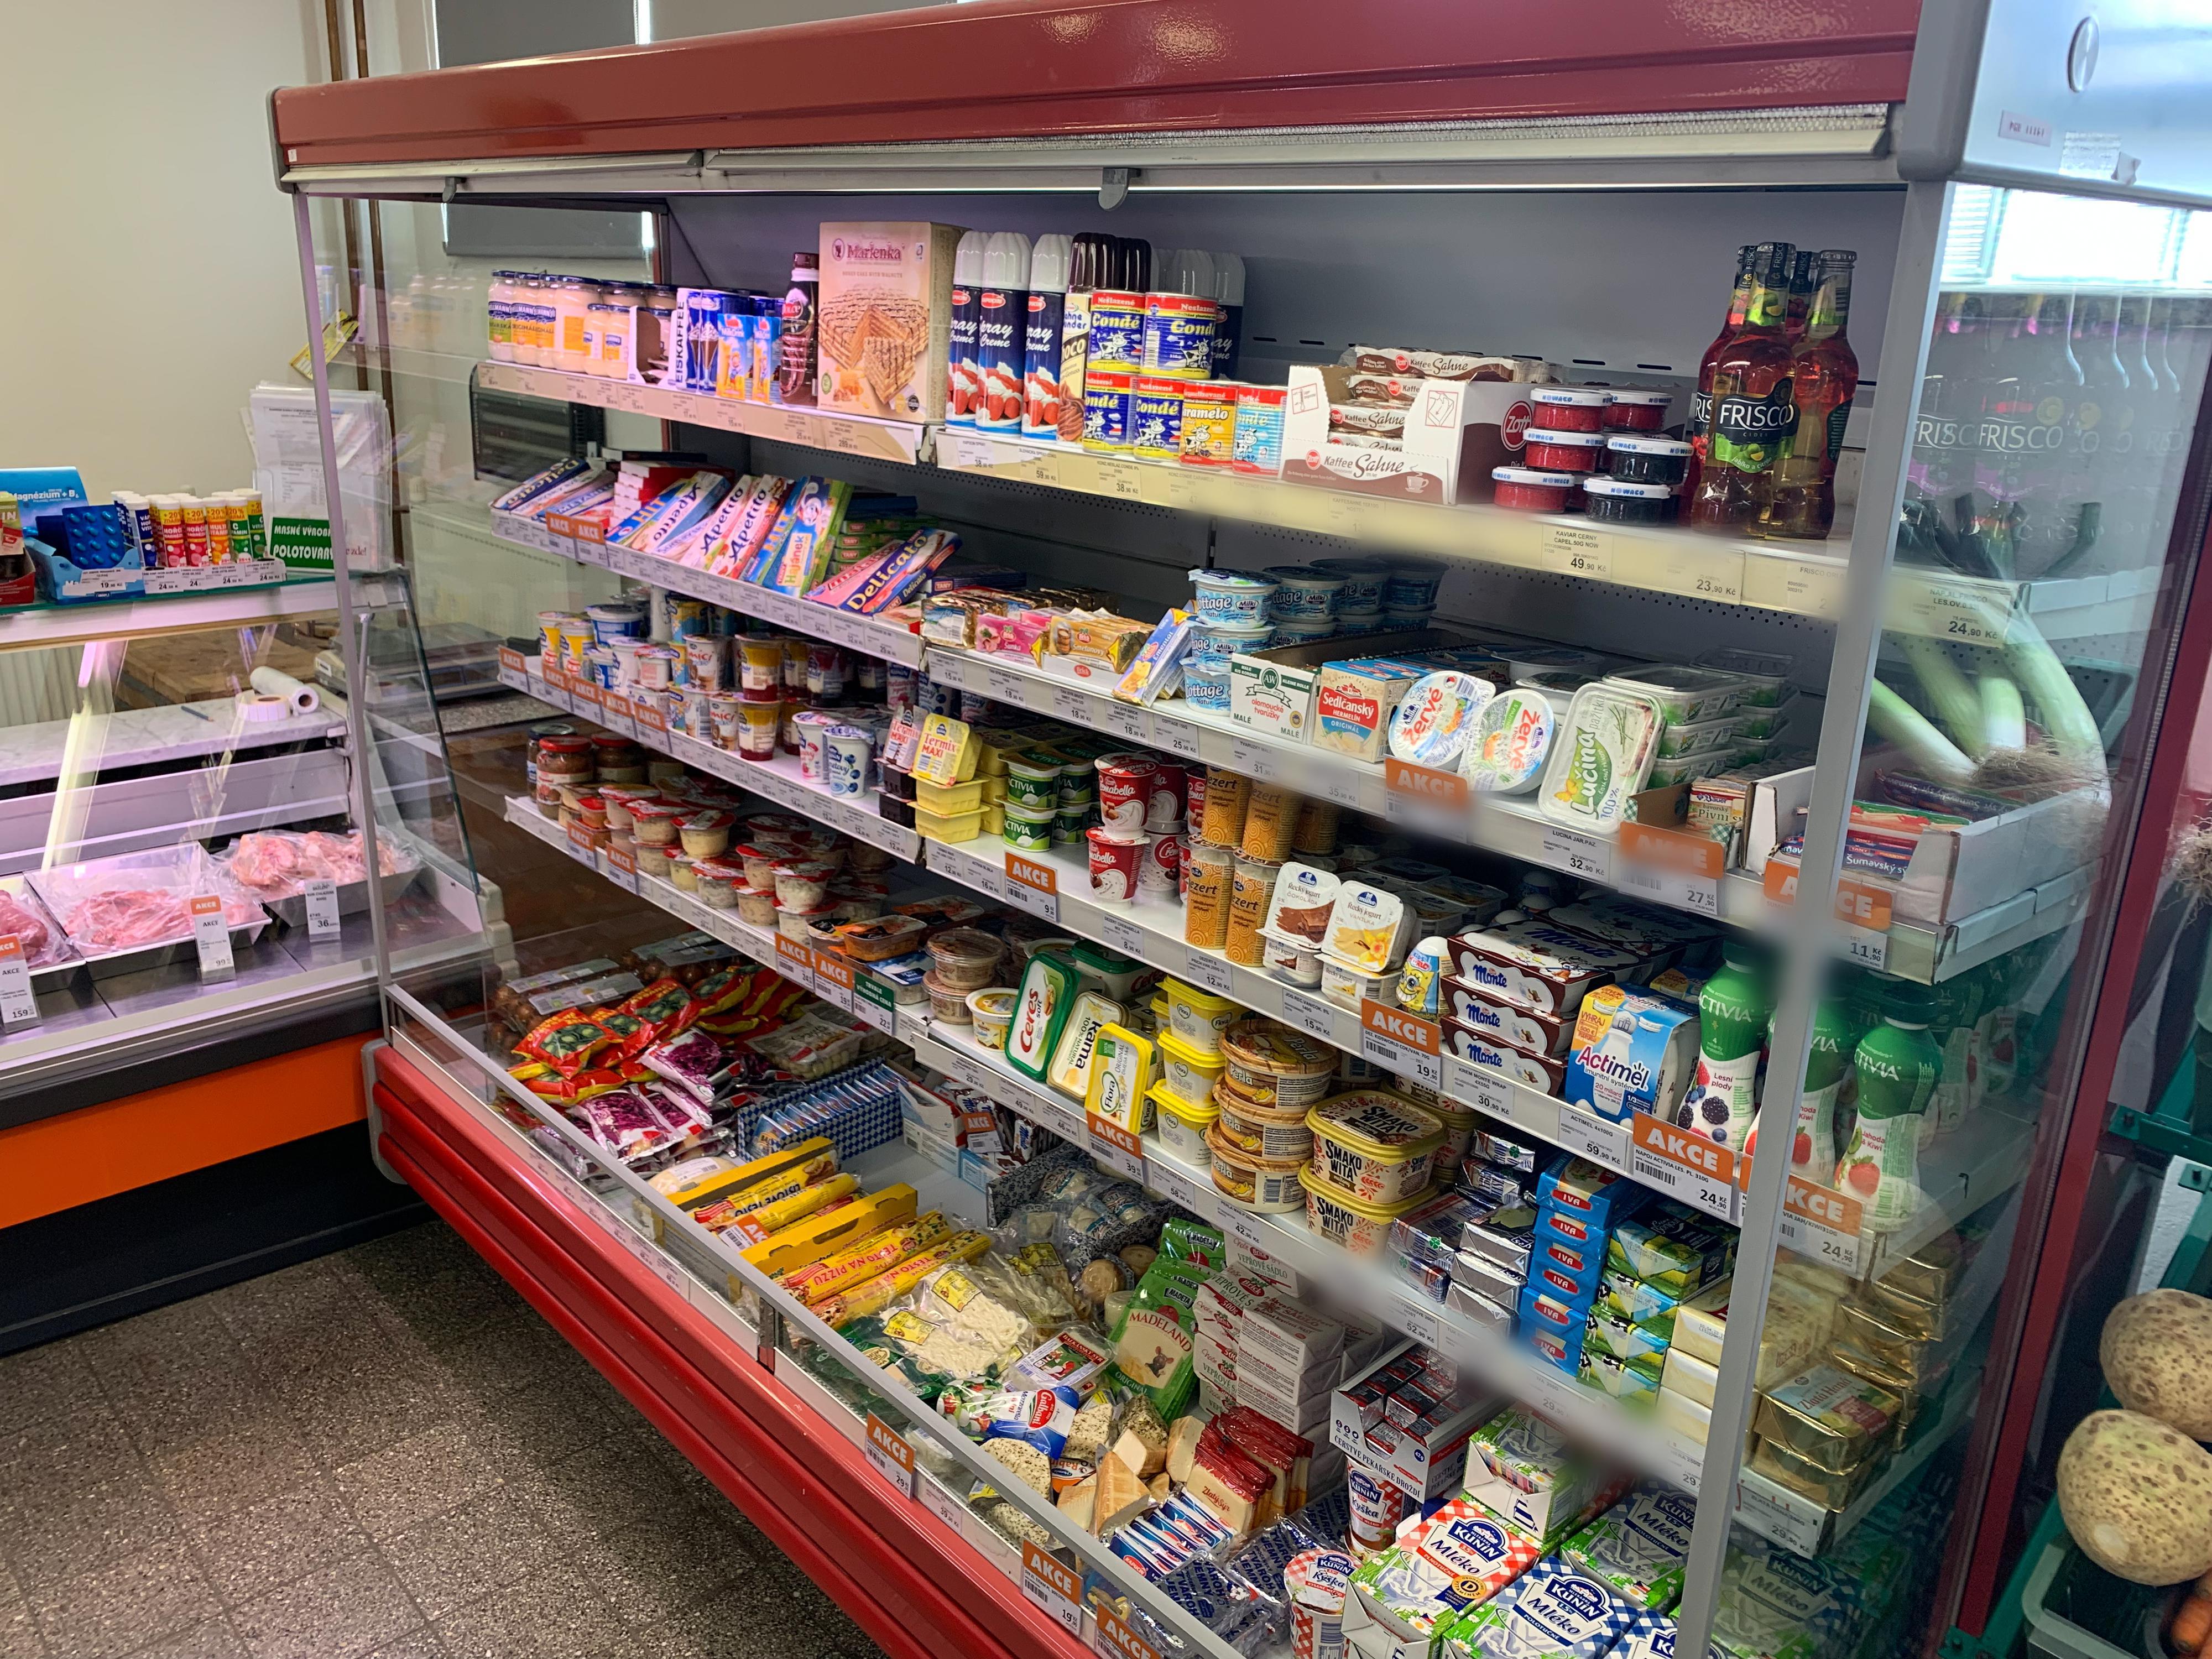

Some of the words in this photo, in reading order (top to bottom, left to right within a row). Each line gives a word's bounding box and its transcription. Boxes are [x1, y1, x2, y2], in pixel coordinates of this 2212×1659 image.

[1092, 313, 1140, 329] Condé
[676, 301, 685, 383] EISKAFFEE
[1344, 414, 1366, 423] Kaffee
[1368, 412, 1405, 428] Sahne
[1719, 404, 1786, 428] FRISCO
[1324, 456, 1353, 469] Kaffee
[1354, 453, 1404, 478] Sahne
[1611, 487, 1644, 495] NOWACO
[550, 518, 570, 533] AKCE
[578, 524, 599, 539] AKCE
[729, 489, 766, 564] Apetito
[847, 535, 928, 610] Delicato
[1004, 641, 1021, 651] Šunka
[1152, 631, 1173, 661] Emental
[639, 708, 661, 726] AKCE
[1323, 692, 1374, 719] Sedlčanský
[1333, 709, 1360, 722] HERMELÍN
[1401, 688, 1443, 746] Žervé
[1233, 713, 1251, 724] MALÉ
[1331, 720, 1359, 733] ORIGINÁL
[924, 733, 957, 752] Termix
[1281, 727, 1300, 738] MALÉ
[922, 745, 943, 758] MAXI
[1397, 769, 1455, 798] AKCE
[1698, 808, 1729, 823] Pivní
[1553, 831, 1572, 839] LUCINA
[1012, 862, 1049, 887] AKCE
[1846, 855, 1896, 874] Šumavský
[195, 900, 217, 910] AKCE
[1365, 907, 1382, 921] jogurt
[780, 944, 806, 963] AKCE
[819, 962, 847, 984] AKCE
[1473, 964, 1507, 988] Monte
[1466, 1003, 1500, 1027] Monte
[1698, 991, 1752, 1022] ACTIVIA
[1020, 988, 1039, 1053] Ceres
[1372, 1010, 1428, 1046] AKCE
[1467, 1043, 1503, 1067] Monte
[1230, 1065, 1253, 1086] Perla
[1458, 1067, 1472, 1076] KREM
[1472, 1071, 1490, 1082] MONTE
[1490, 1078, 1507, 1090] WRAP
[1577, 1046, 1649, 1090] Actimel
[1585, 1068, 1609, 1082] imunitní
[1714, 1072, 1733, 1083] Lesní
[1104, 1079, 1119, 1111] Flora
[1604, 1087, 1622, 1098] miliard
[1712, 1079, 1732, 1091] plody
[968, 1117, 989, 1129] AKCE
[1571, 1115, 1595, 1129] ACTIMEL
[1595, 1124, 1613, 1137] 4x100G
[1094, 1120, 1134, 1152] AKCE
[1867, 1140, 1882, 1151] Kiwi
[1325, 1139, 1362, 1171] SMAKO
[1646, 1128, 1719, 1172] AKCE
[1331, 1157, 1357, 1181] WITA
[1636, 1149, 1651, 1159] NAPOJ
[1651, 1155, 1674, 1167] ACTIVIA
[1674, 1164, 1684, 1172] LES.
[1695, 1172, 1709, 1183] 310G
[1562, 1193, 1580, 1206] IVA
[1699, 1188, 1718, 1204] 24
[1719, 1195, 1727, 1203] Kč
[1317, 1194, 1354, 1226] SMAKO
[1322, 1214, 1349, 1238] WITA
[1559, 1223, 1576, 1235] IVA
[1557, 1252, 1574, 1265] IVA
[1822, 1241, 1841, 1255] 24
[1552, 1275, 1569, 1288] IVA
[1169, 1289, 1191, 1305] MADETA
[1543, 1307, 1559, 1319] IVA
[1129, 1312, 1192, 1353] MADELAND
[1033, 1392, 1052, 1425] Galbani
[873, 1427, 908, 1464] AKCE
[1415, 1451, 1424, 1461] 42g
[1363, 1453, 1395, 1483] PEKAŘSKÉ
[1396, 1477, 1421, 1498] DROŽDÍ
[1201, 1485, 1219, 1505] Zlatý
[1218, 1498, 1230, 1513] Sýr
[1350, 1480, 1378, 1500] KUNÍN
[1352, 1496, 1379, 1518] Kyška
[1637, 1512, 1689, 1546] Mléko
[1454, 1526, 1500, 1558] KUNÍN
[1320, 1560, 1352, 1574] KUNÍN
[1423, 1553, 1455, 1577] PLNOTUČNÉ
[1430, 1540, 1481, 1574] Mléko
[1030, 1552, 1073, 1592] AKCE
[1247, 1551, 1272, 1590] TVAROH
[1552, 1583, 1600, 1617] KUNÍN
[1524, 1614, 1560, 1640] POLOTUČNÉ
[1527, 1598, 1581, 1636] Mléko
[1105, 1618, 1151, 1659] AKCE
